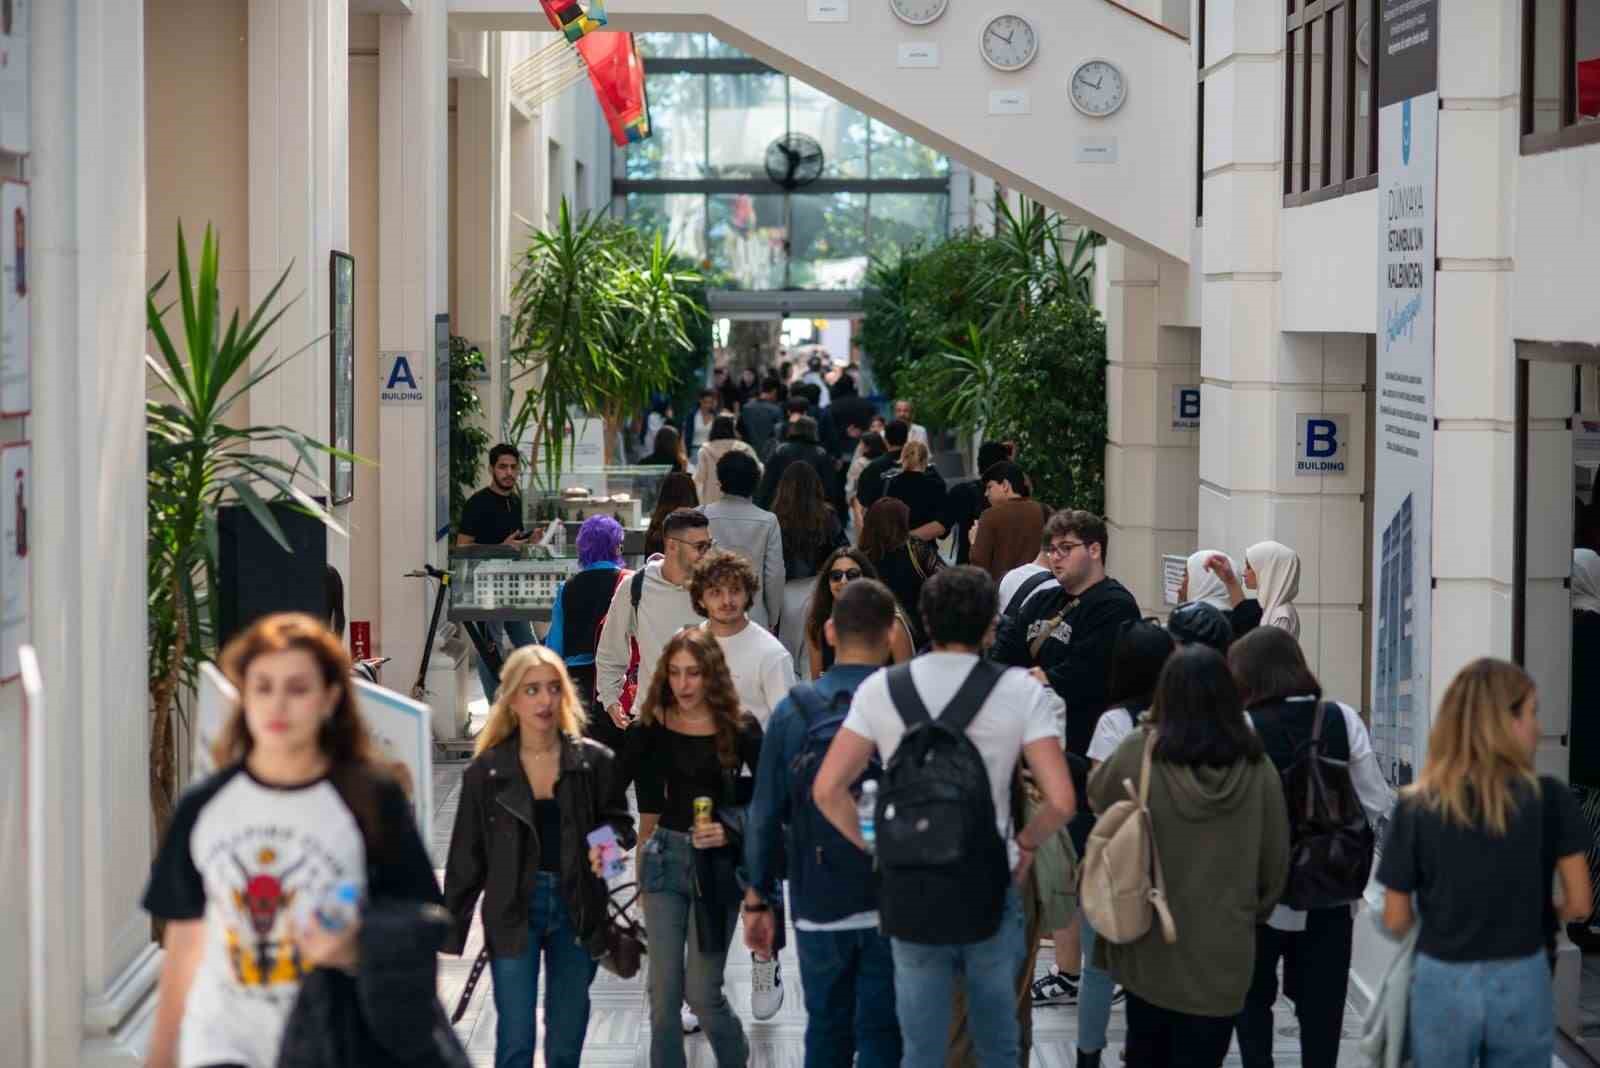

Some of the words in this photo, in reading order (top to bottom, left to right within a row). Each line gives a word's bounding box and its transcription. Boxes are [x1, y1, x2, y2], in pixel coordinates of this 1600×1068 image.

[1387, 255, 1423, 288] KALBİNDEN
[387, 356, 417, 389] A
[381, 392, 423, 401] BUILDING
[1180, 389, 1200, 418] B
[1306, 419, 1338, 457] B
[1297, 461, 1345, 471] BUILDING
